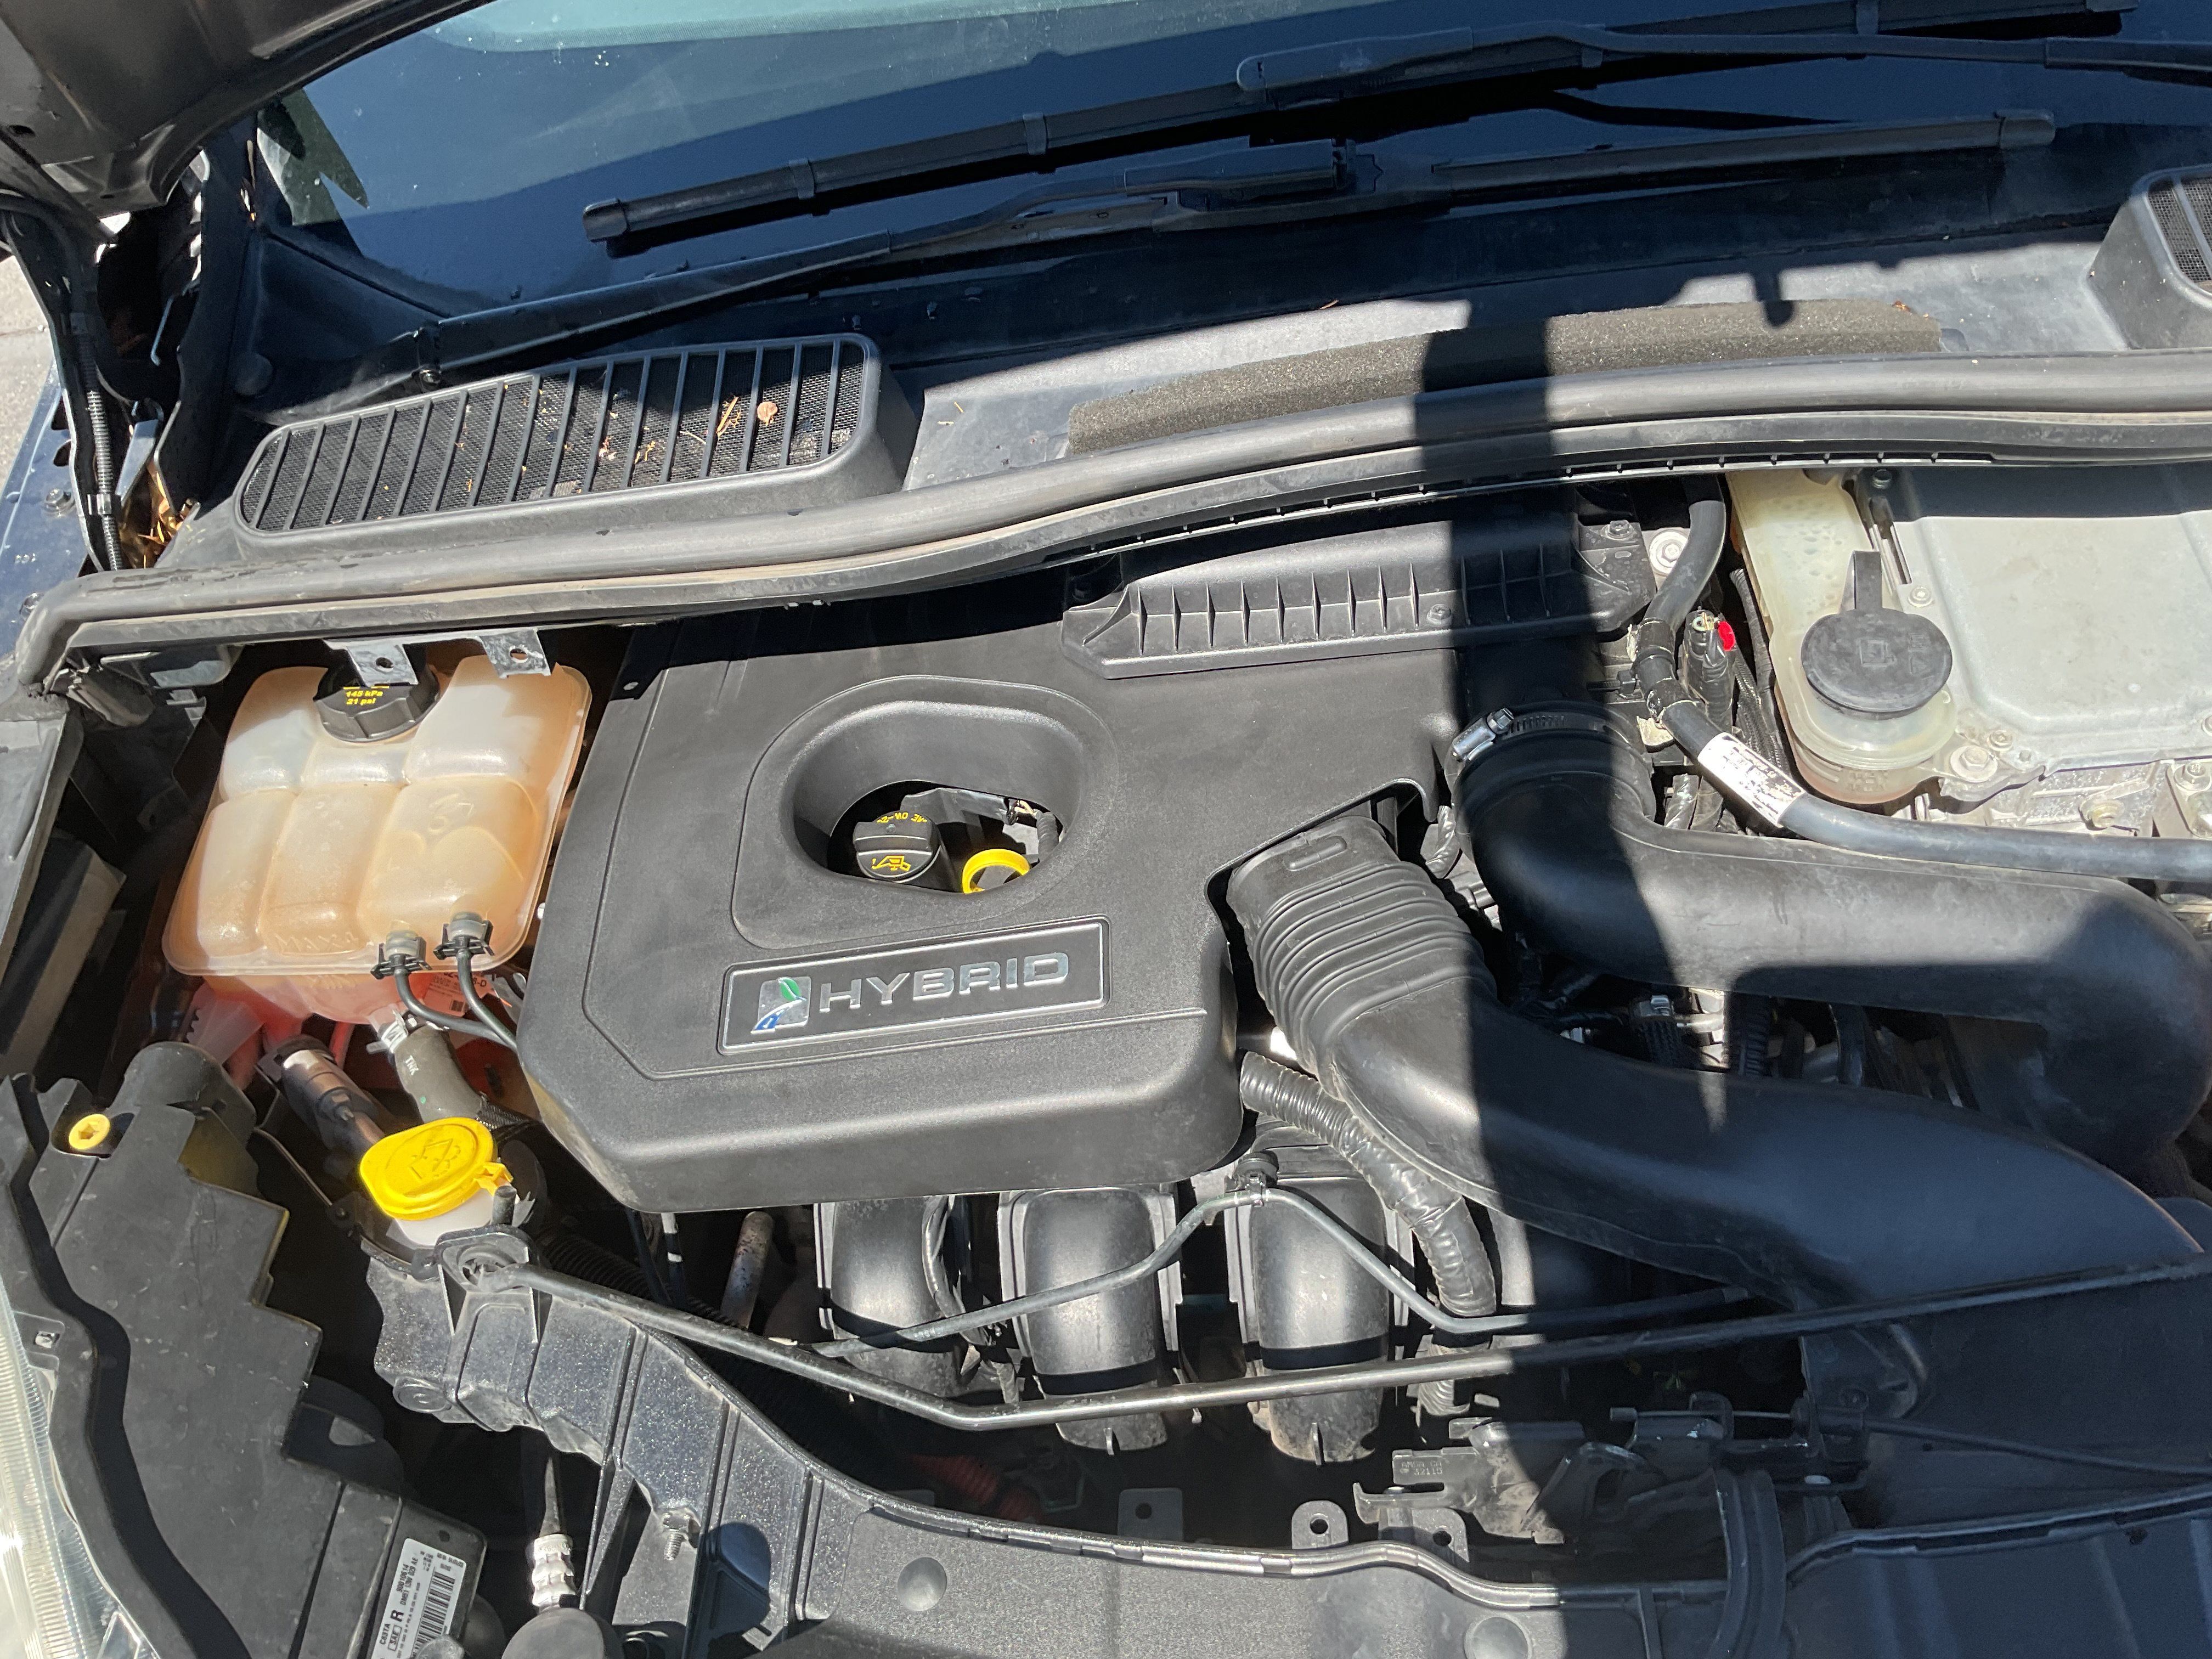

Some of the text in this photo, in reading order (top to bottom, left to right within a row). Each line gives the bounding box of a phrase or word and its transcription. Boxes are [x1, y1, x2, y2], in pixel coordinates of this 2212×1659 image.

[360, 697, 376, 706] psi
[819, 952, 1070, 1013] HYBRID
[390, 1610, 404, 1622] R
